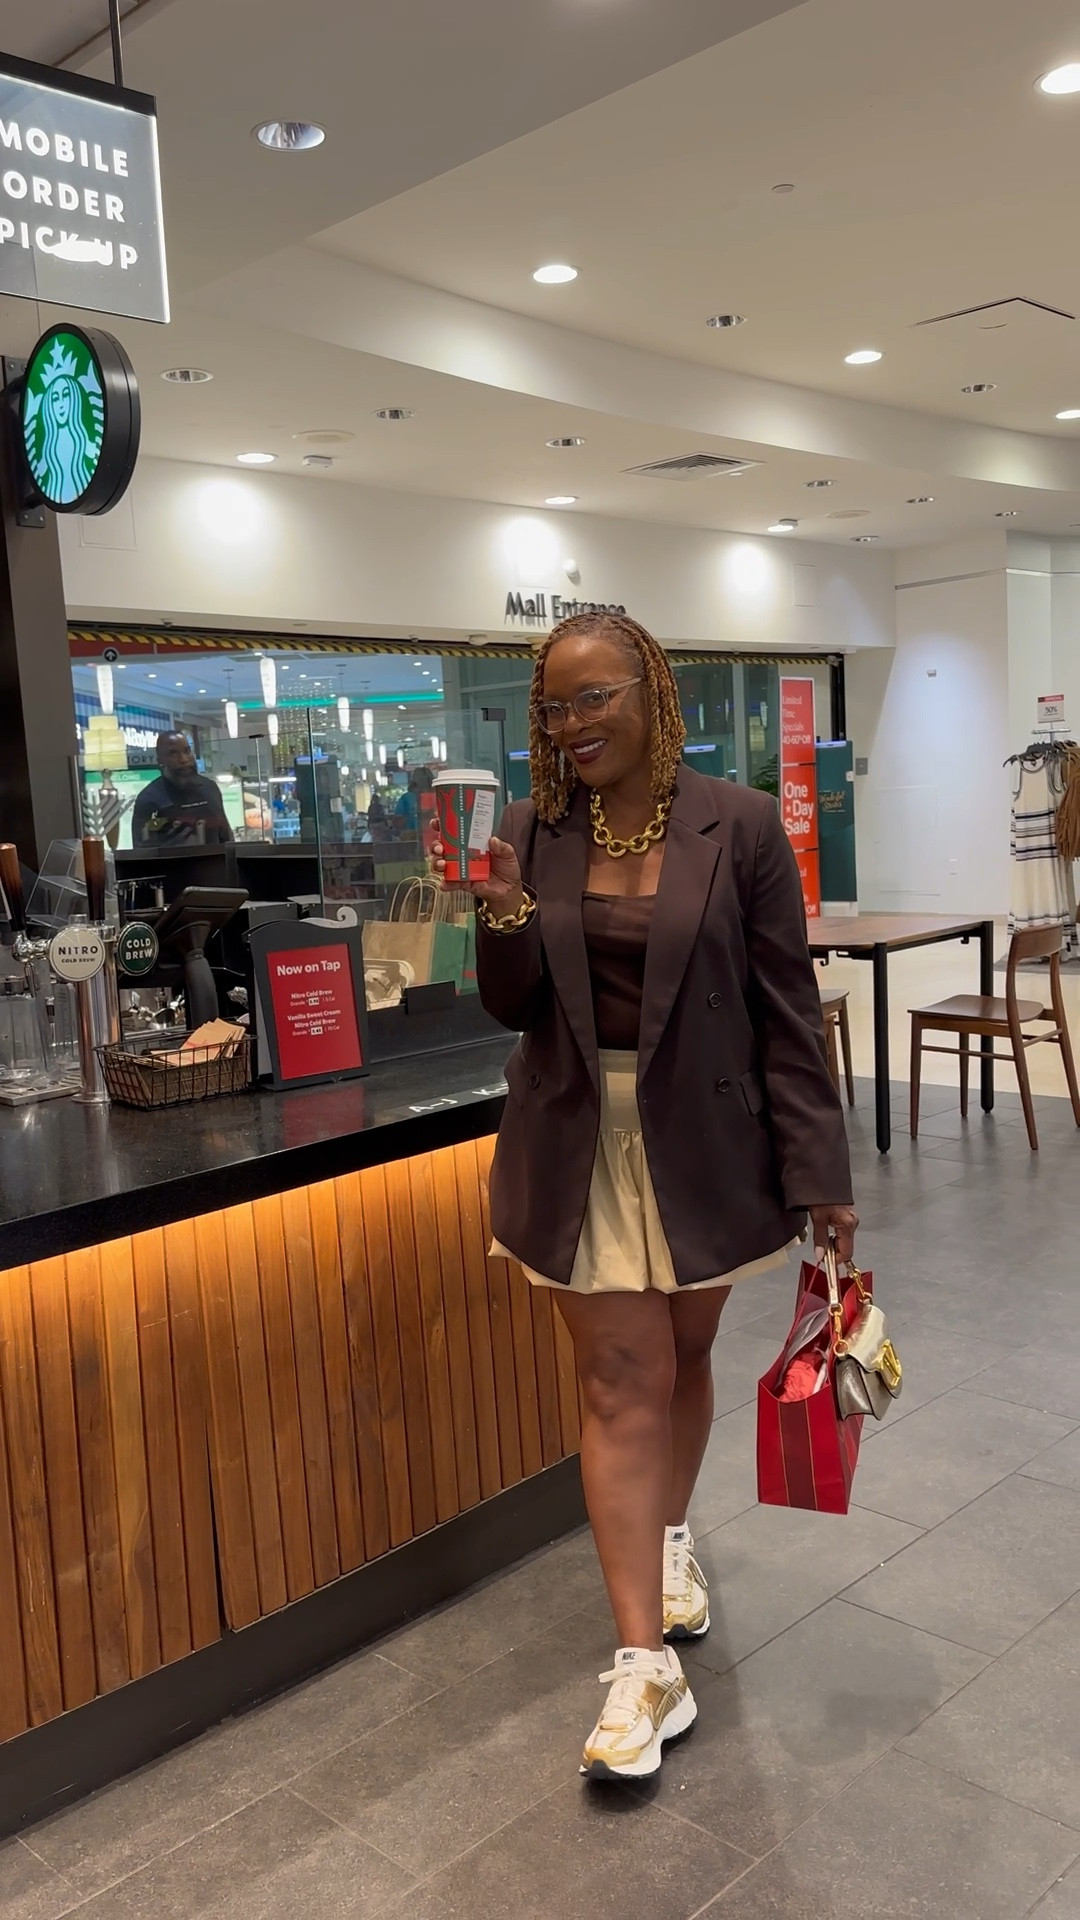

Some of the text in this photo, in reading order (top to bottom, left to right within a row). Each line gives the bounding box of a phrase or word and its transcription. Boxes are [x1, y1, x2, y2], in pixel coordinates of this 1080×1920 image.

[0, 119, 129, 177] MOBILE
[3, 171, 125, 223] ORDER
[506, 592, 547, 617] Mall
[784, 781, 808, 798] One
[793, 799, 814, 819] Day
[785, 817, 810, 836] Sale
[58, 946, 98, 955] NITRO
[126, 938, 151, 949] COLD
[125, 948, 153, 960] BREW
[277, 961, 341, 976] Now on Tap
[621, 1652, 636, 1660] NIKE
